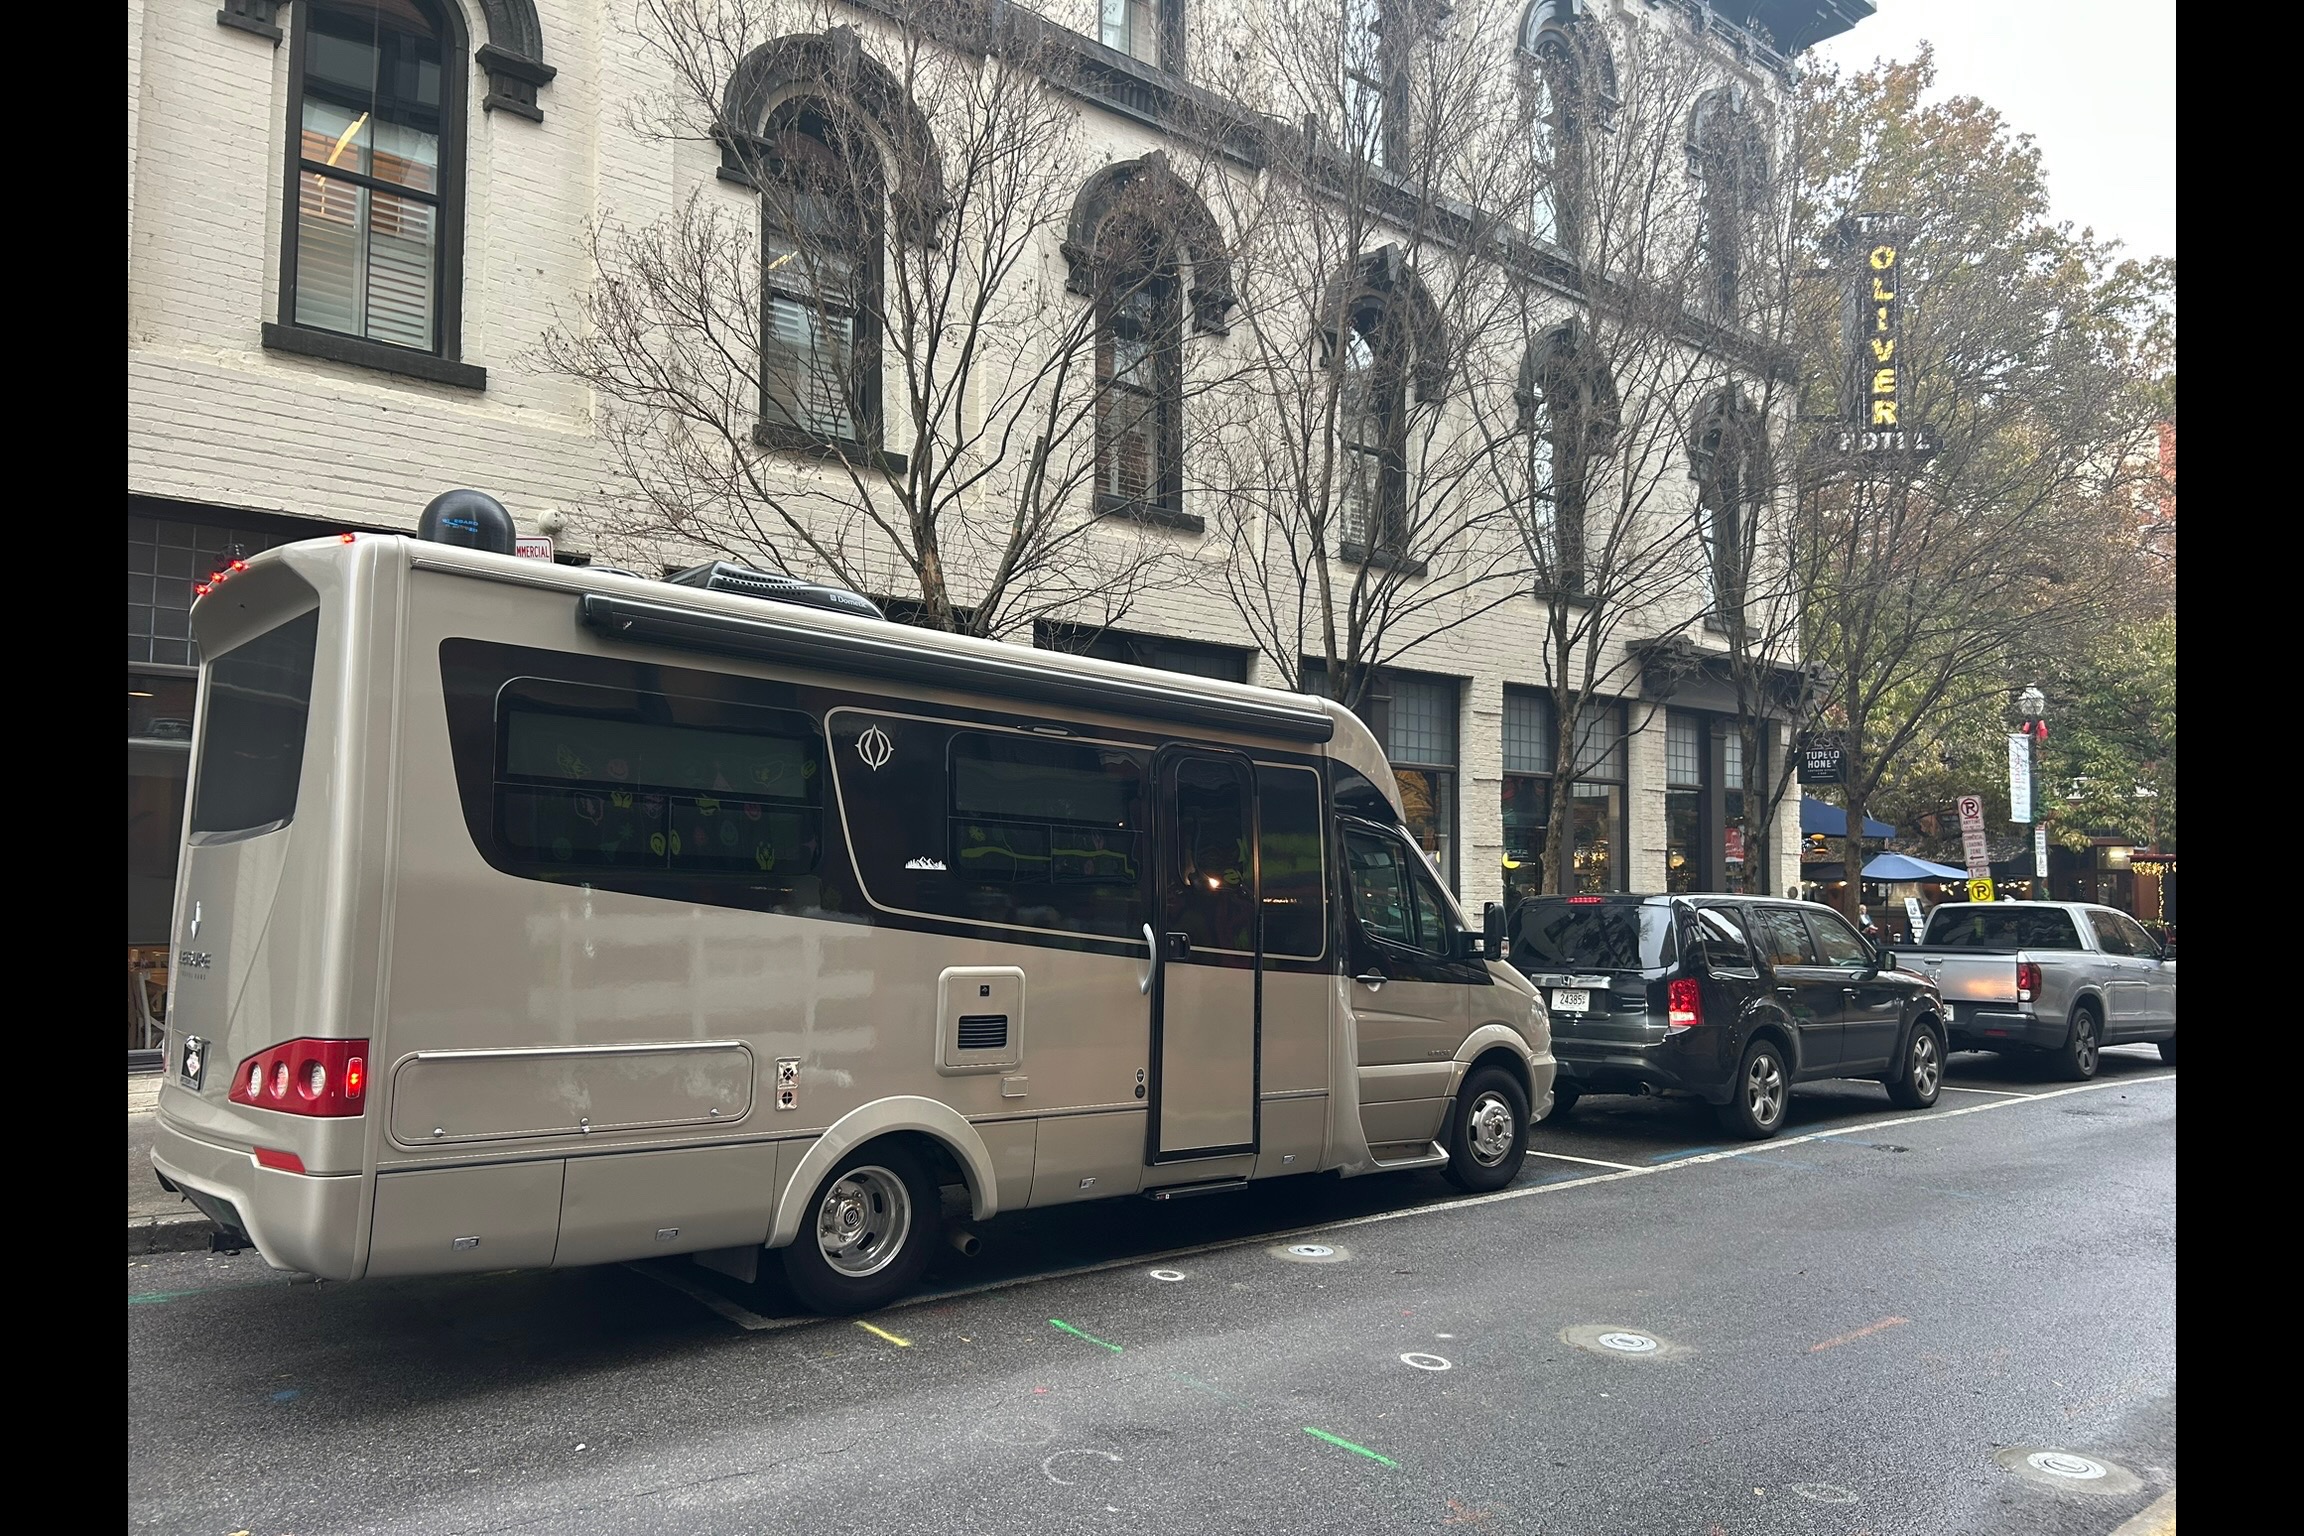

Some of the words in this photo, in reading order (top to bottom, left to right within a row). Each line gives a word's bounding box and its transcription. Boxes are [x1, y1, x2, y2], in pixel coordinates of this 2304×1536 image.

[1869, 245, 1898, 426] OLIVER
[516, 545, 550, 558] MMERCIAL
[1806, 750, 1840, 760] TUPELO
[1807, 759, 1837, 768] HONEY
[1560, 994, 1583, 1005] 24385
